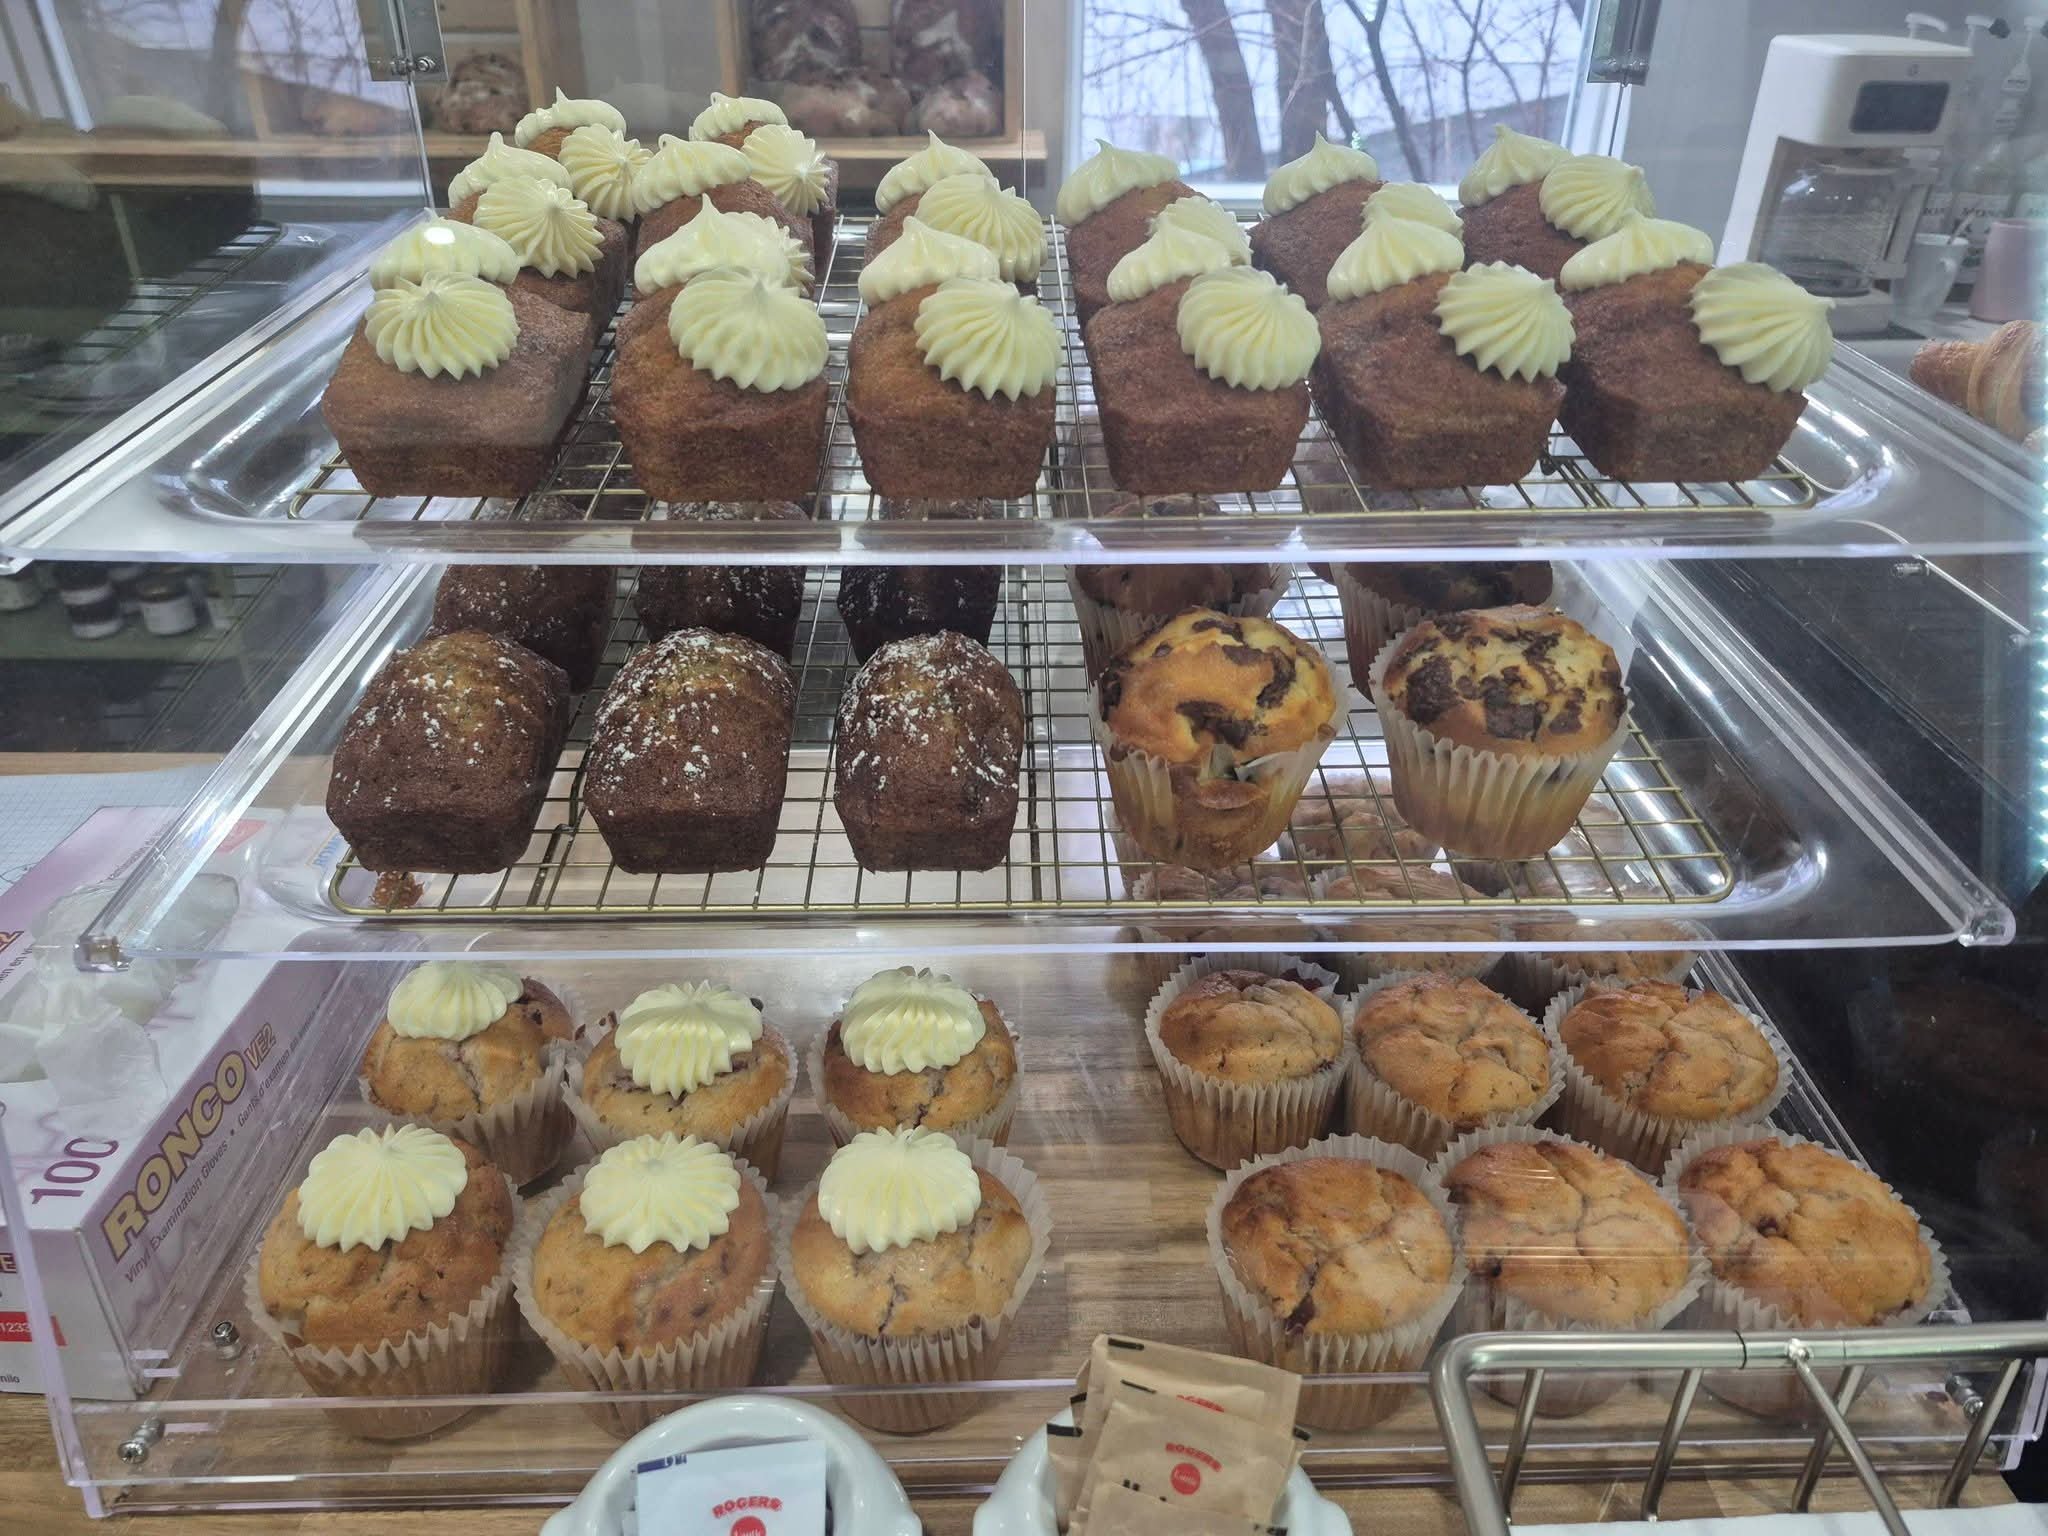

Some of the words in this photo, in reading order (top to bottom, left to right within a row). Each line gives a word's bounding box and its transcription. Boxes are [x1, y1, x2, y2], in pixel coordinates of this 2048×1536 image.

[102, 1050, 247, 1264] RONCO
[244, 1022, 277, 1071] VE2
[124, 1246, 152, 1283] Vinyl
[150, 1176, 204, 1251] Examination
[201, 1139, 229, 1182] Gloves
[1165, 1442, 1222, 1473] ROGERS
[712, 1496, 783, 1519] ROGERS
